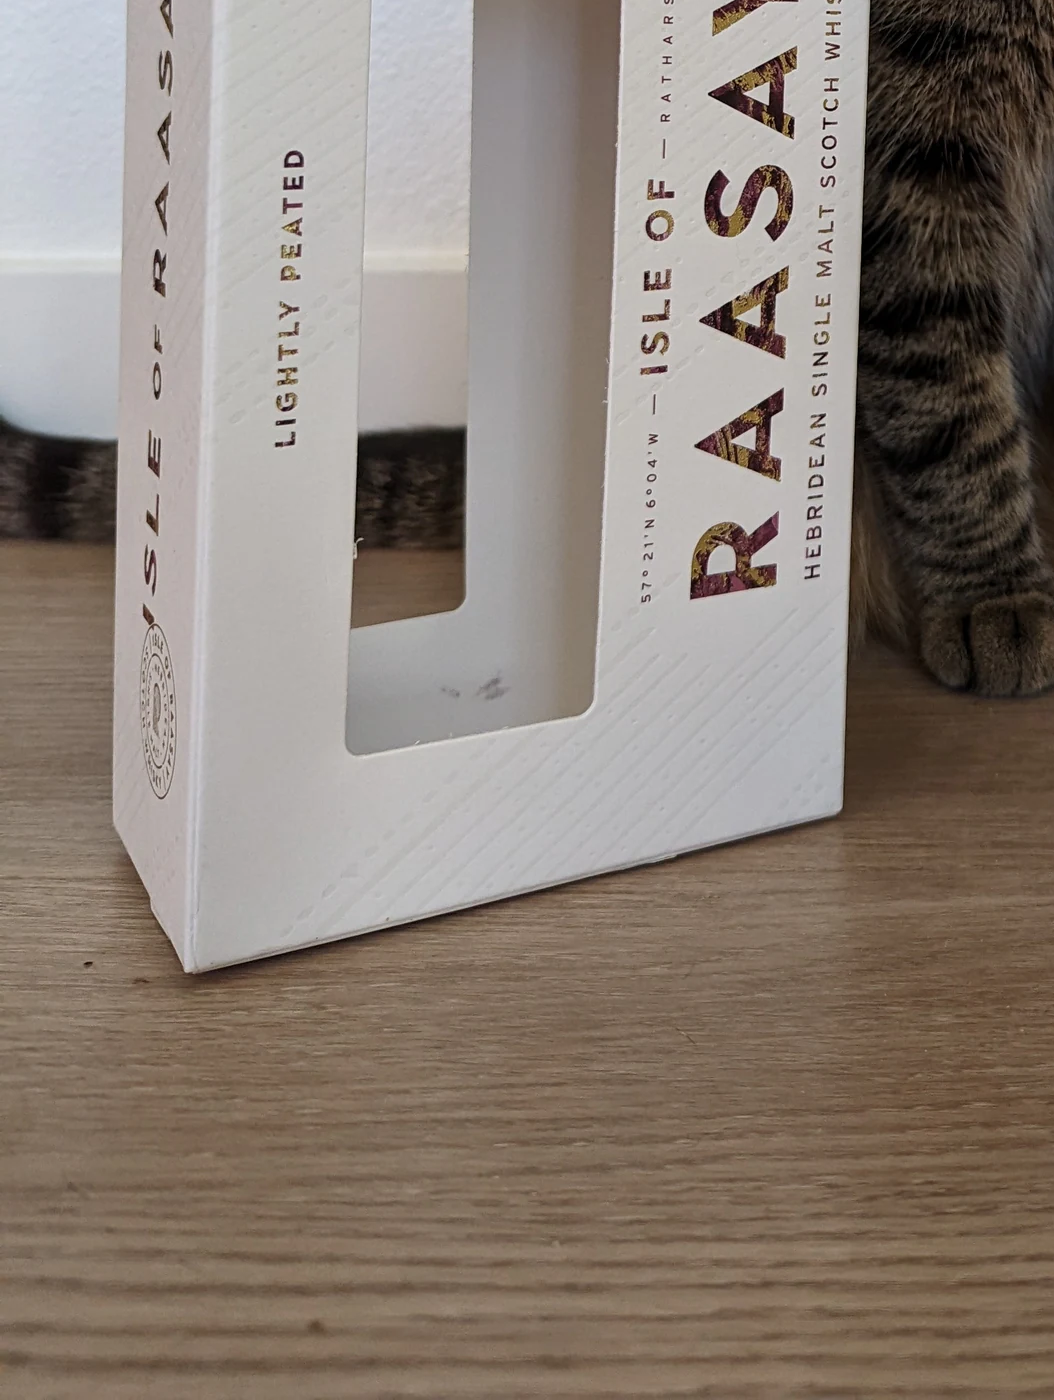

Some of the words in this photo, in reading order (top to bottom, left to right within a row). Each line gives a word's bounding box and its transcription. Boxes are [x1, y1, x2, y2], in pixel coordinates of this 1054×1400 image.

[819, 77, 840, 188] SCOTCH
[280, 150, 305, 282] PEATED
[644, 178, 675, 242] OF
[815, 204, 835, 278] MALT
[274, 300, 300, 448] LIGHTLY
[639, 268, 673, 376] ISLE
[811, 293, 832, 397] SINGLE
[142, 428, 161, 629] ISLE
[152, 324, 163, 401] OF
[803, 413, 827, 579] HEBRIDEAN
[642, 518, 656, 561] 21'N
